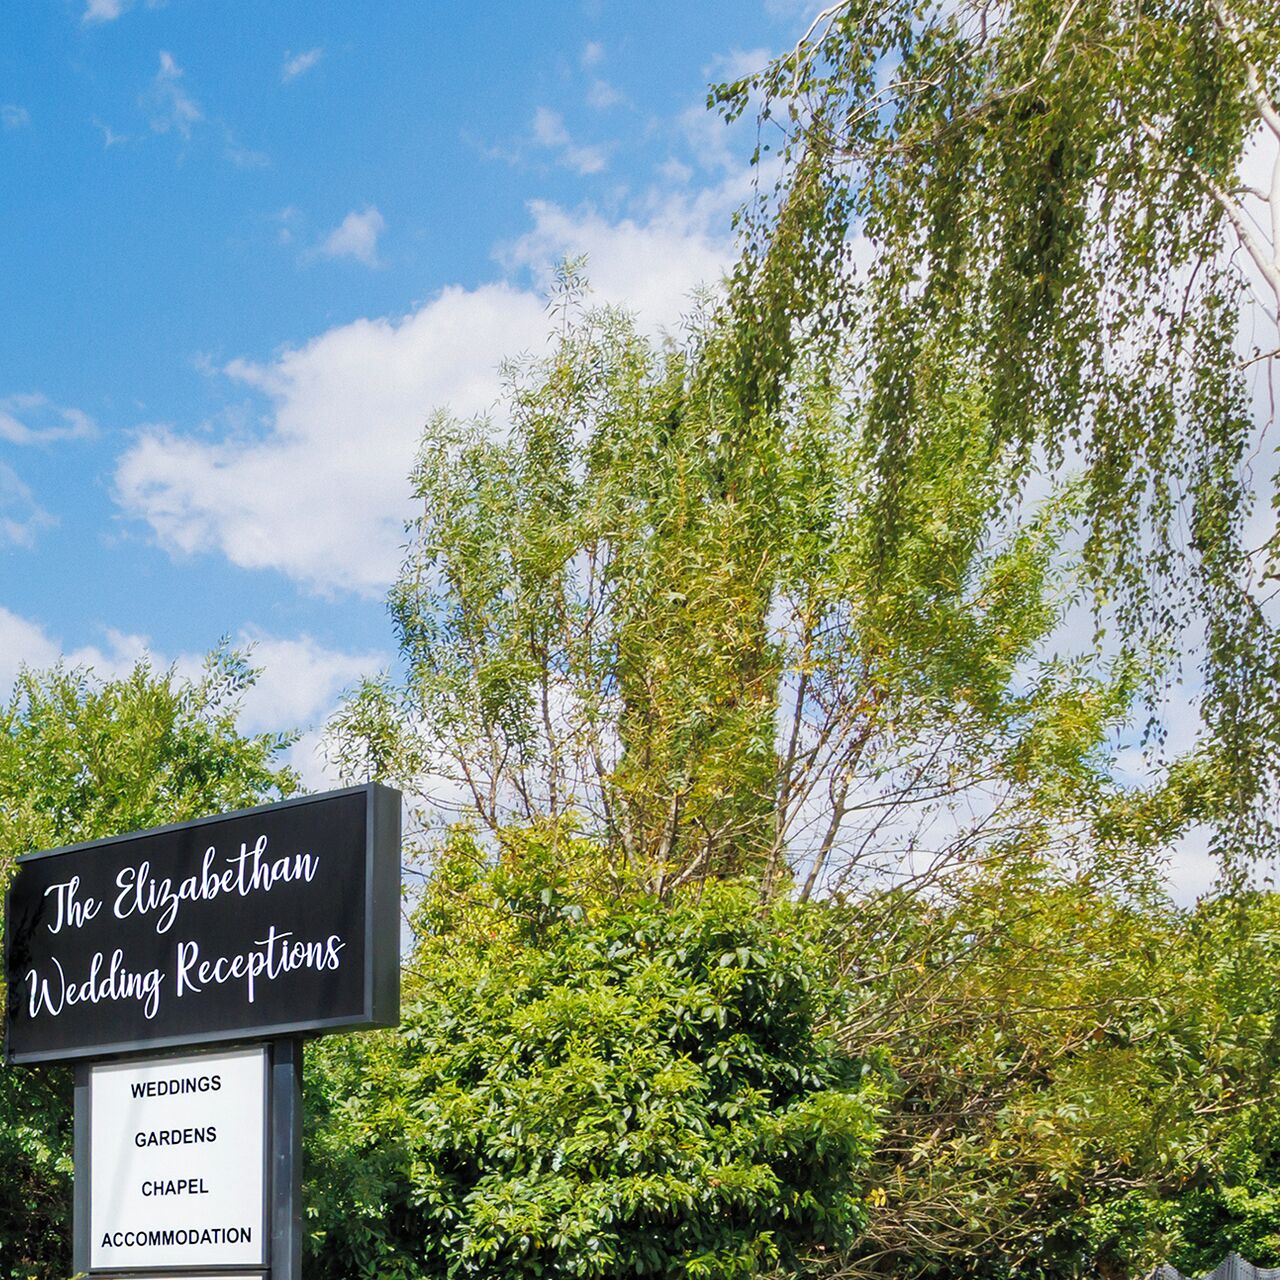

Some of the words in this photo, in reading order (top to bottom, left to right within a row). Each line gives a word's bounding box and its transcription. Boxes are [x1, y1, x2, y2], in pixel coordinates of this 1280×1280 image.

[43, 875, 103, 934] The
[113, 834, 320, 934] Elizabethan
[24, 948, 166, 1020] Wedding
[176, 925, 346, 1003] Receptions
[130, 1075, 222, 1099] WEDDINGS
[134, 1126, 217, 1148] GARDENS
[141, 1178, 209, 1197] CHAPEL
[101, 1227, 252, 1248] ACCOMMODATION
